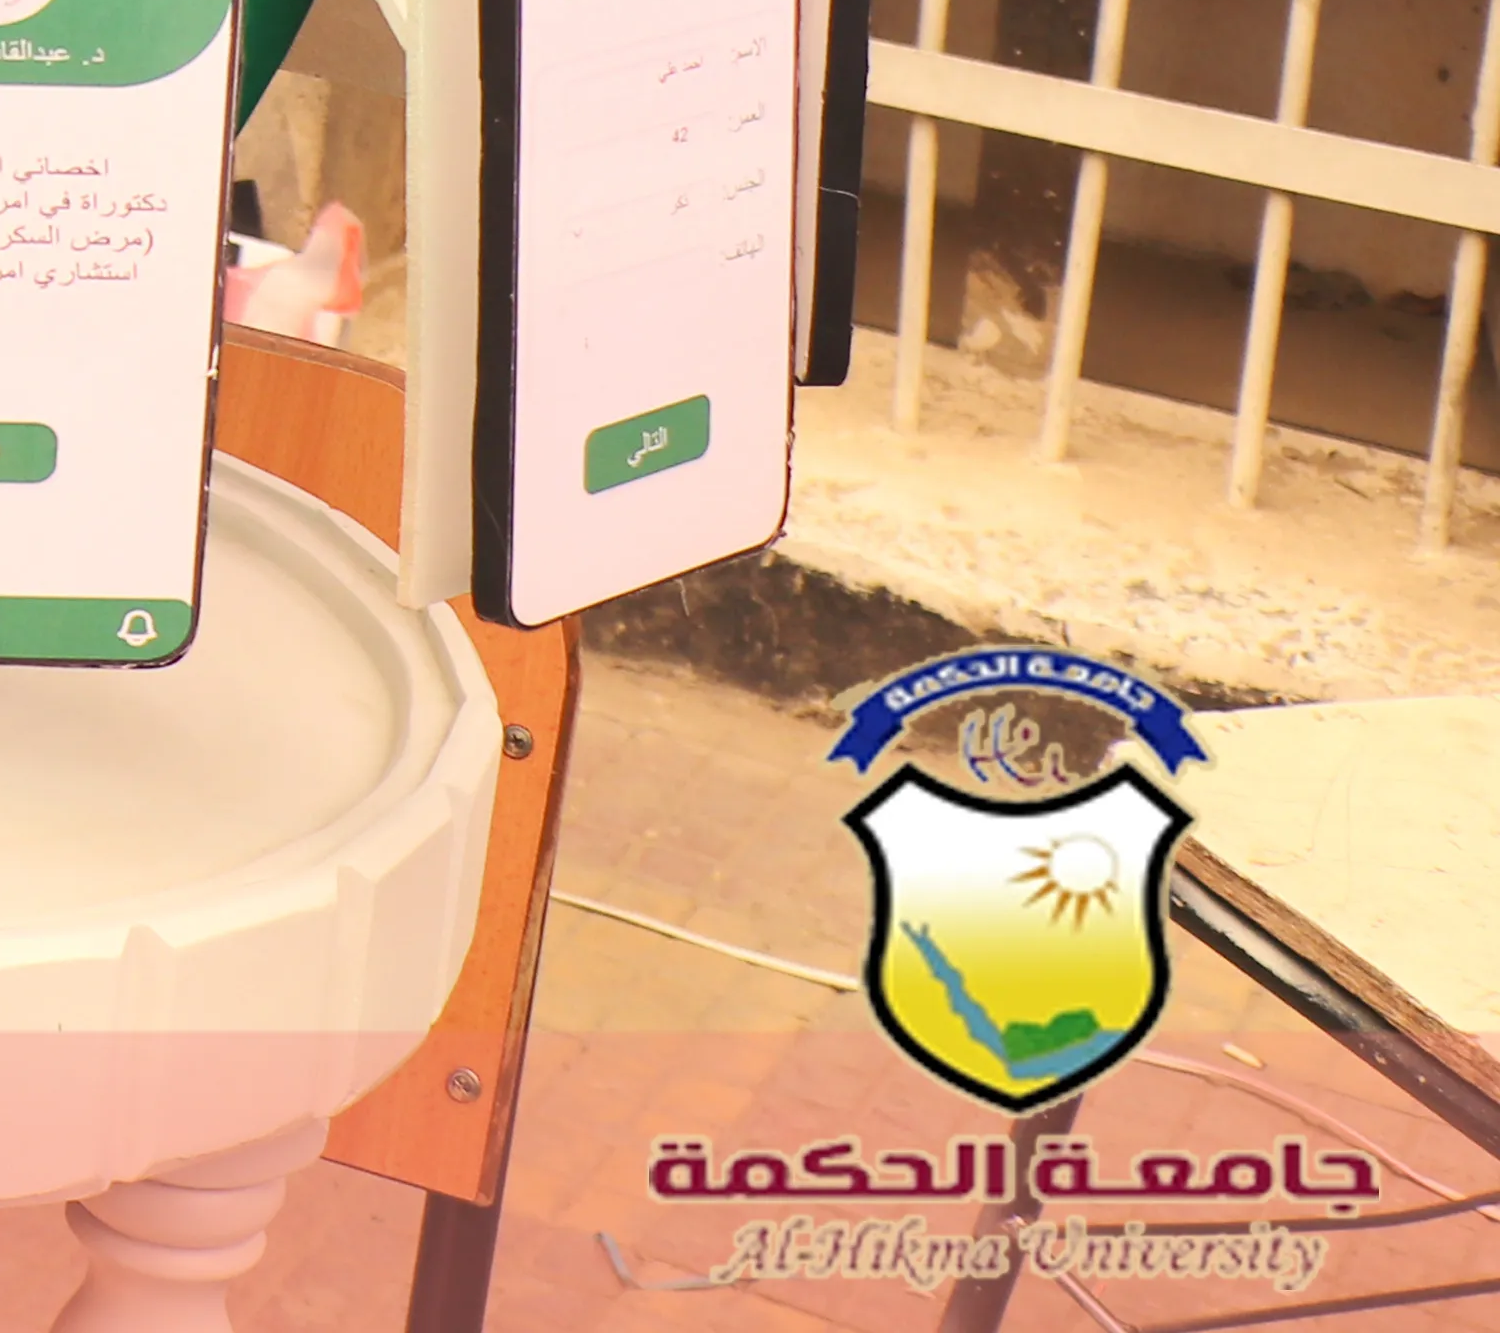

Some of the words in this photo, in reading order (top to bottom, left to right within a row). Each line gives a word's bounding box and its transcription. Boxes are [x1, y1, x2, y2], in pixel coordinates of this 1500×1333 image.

[82, 44, 105, 67] د.
[671, 126, 689, 144] 42
[38, 191, 72, 218] في
[80, 191, 169, 218] دكتوراة
[33, 260, 139, 289] استشاري
[626, 425, 669, 469] التالي
